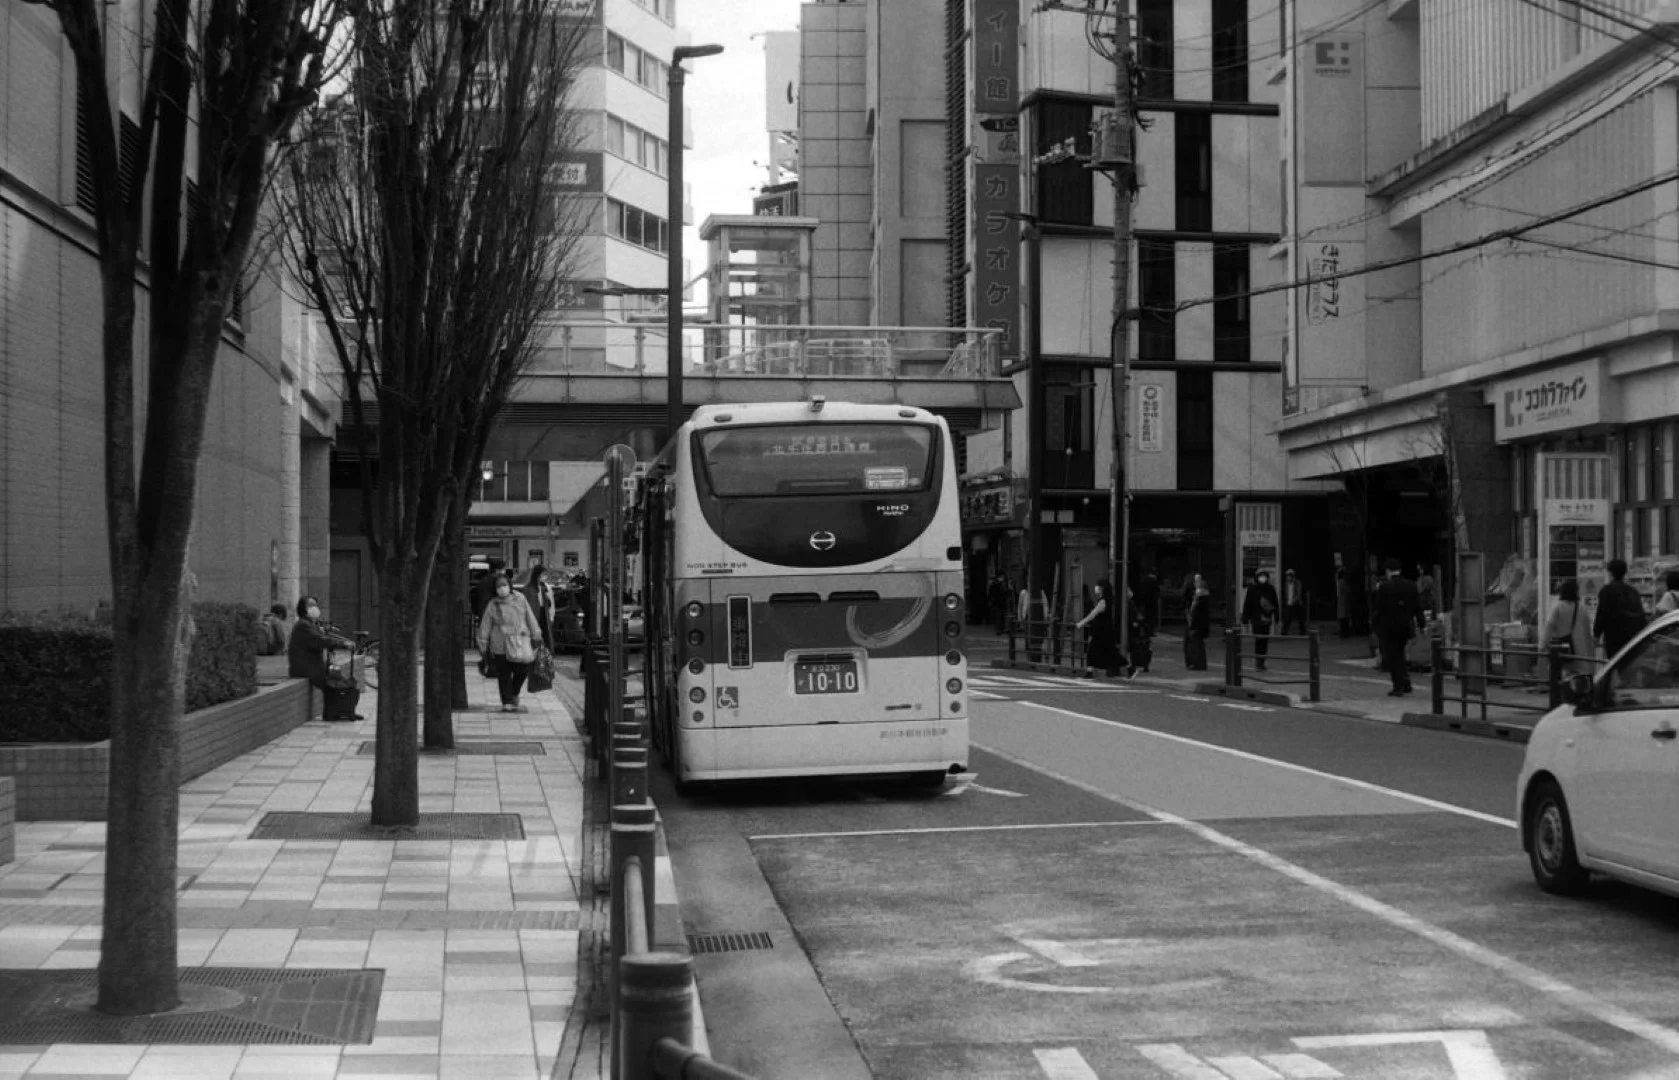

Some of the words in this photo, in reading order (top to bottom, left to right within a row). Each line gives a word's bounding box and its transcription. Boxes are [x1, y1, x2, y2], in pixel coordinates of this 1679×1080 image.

[1524, 376, 1587, 411] ココカラファイン
